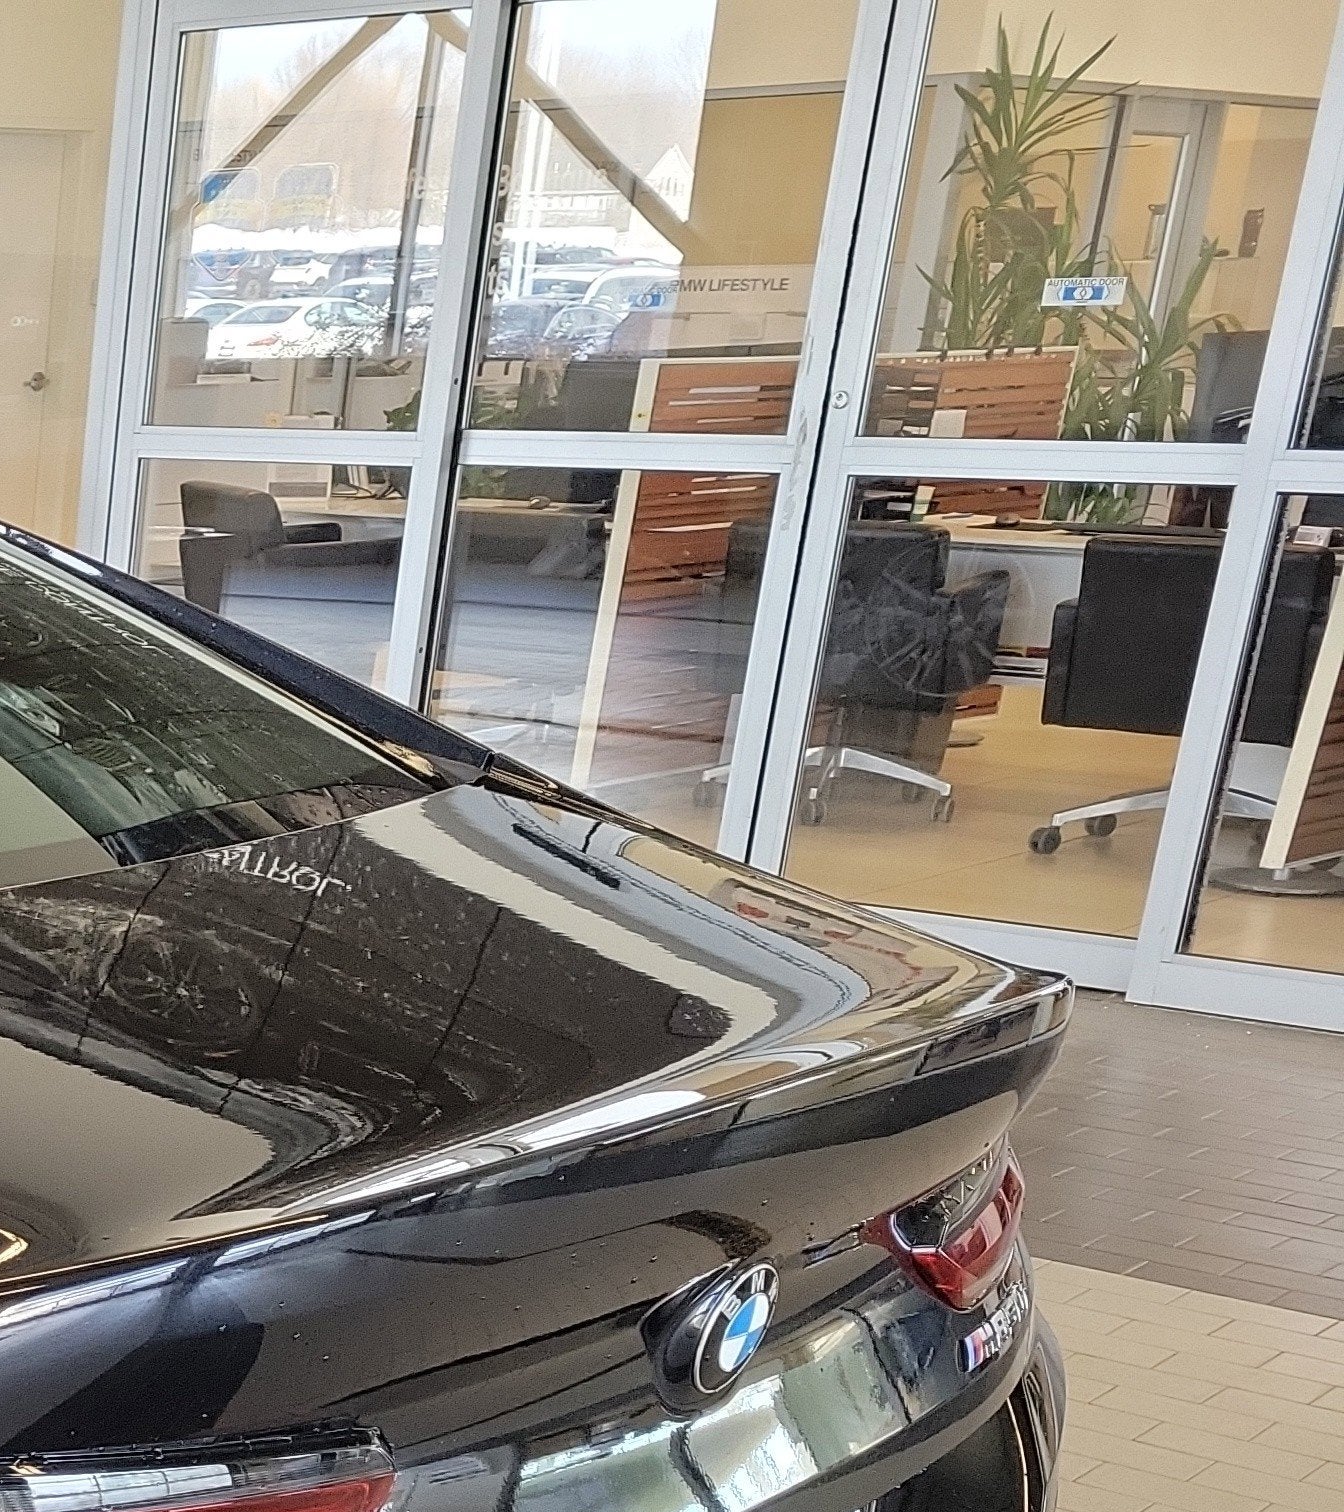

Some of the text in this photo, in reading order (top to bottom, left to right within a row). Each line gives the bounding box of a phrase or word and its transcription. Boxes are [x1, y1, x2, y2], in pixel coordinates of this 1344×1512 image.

[708, 278, 790, 292] LIFESTYLE
[1048, 278, 1125, 287] AUTOMATIC DOOR
